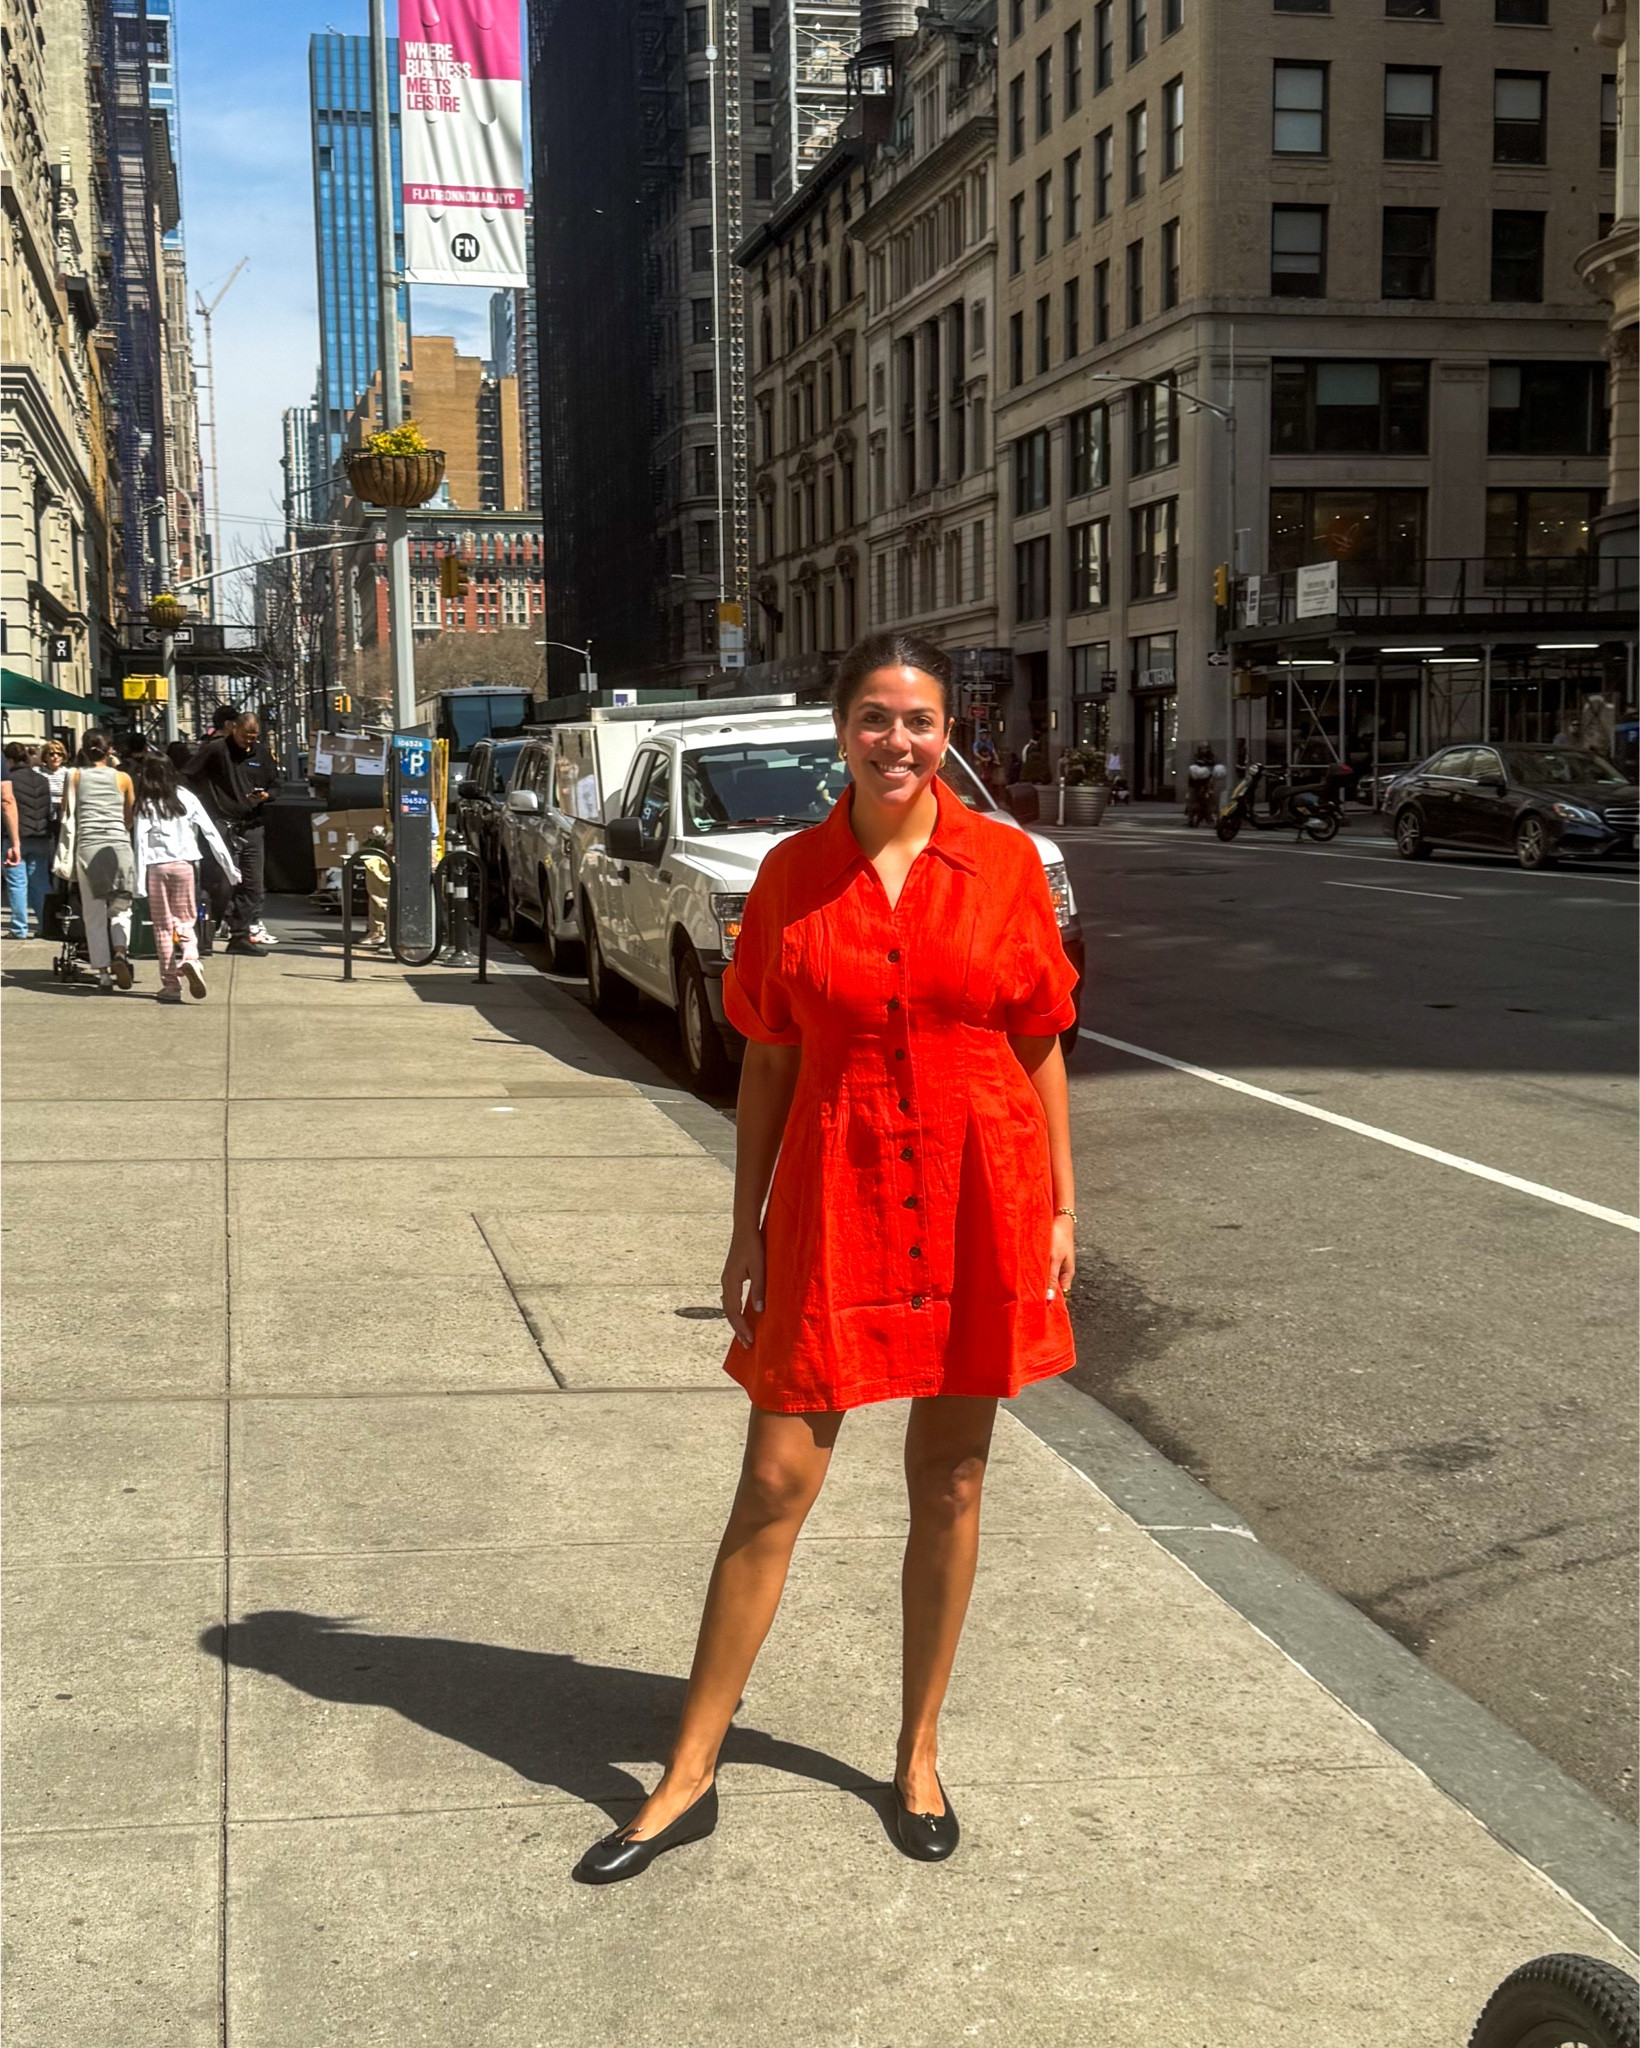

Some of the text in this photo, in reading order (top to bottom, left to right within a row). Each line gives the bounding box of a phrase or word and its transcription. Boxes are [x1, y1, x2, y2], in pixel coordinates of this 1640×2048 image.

[405, 42, 453, 60] WHERE
[406, 60, 472, 79] BUSINESS
[407, 78, 451, 95] MEETS
[407, 95, 460, 112] LEISURE
[455, 238, 476, 257] FN
[410, 753, 424, 775] P
